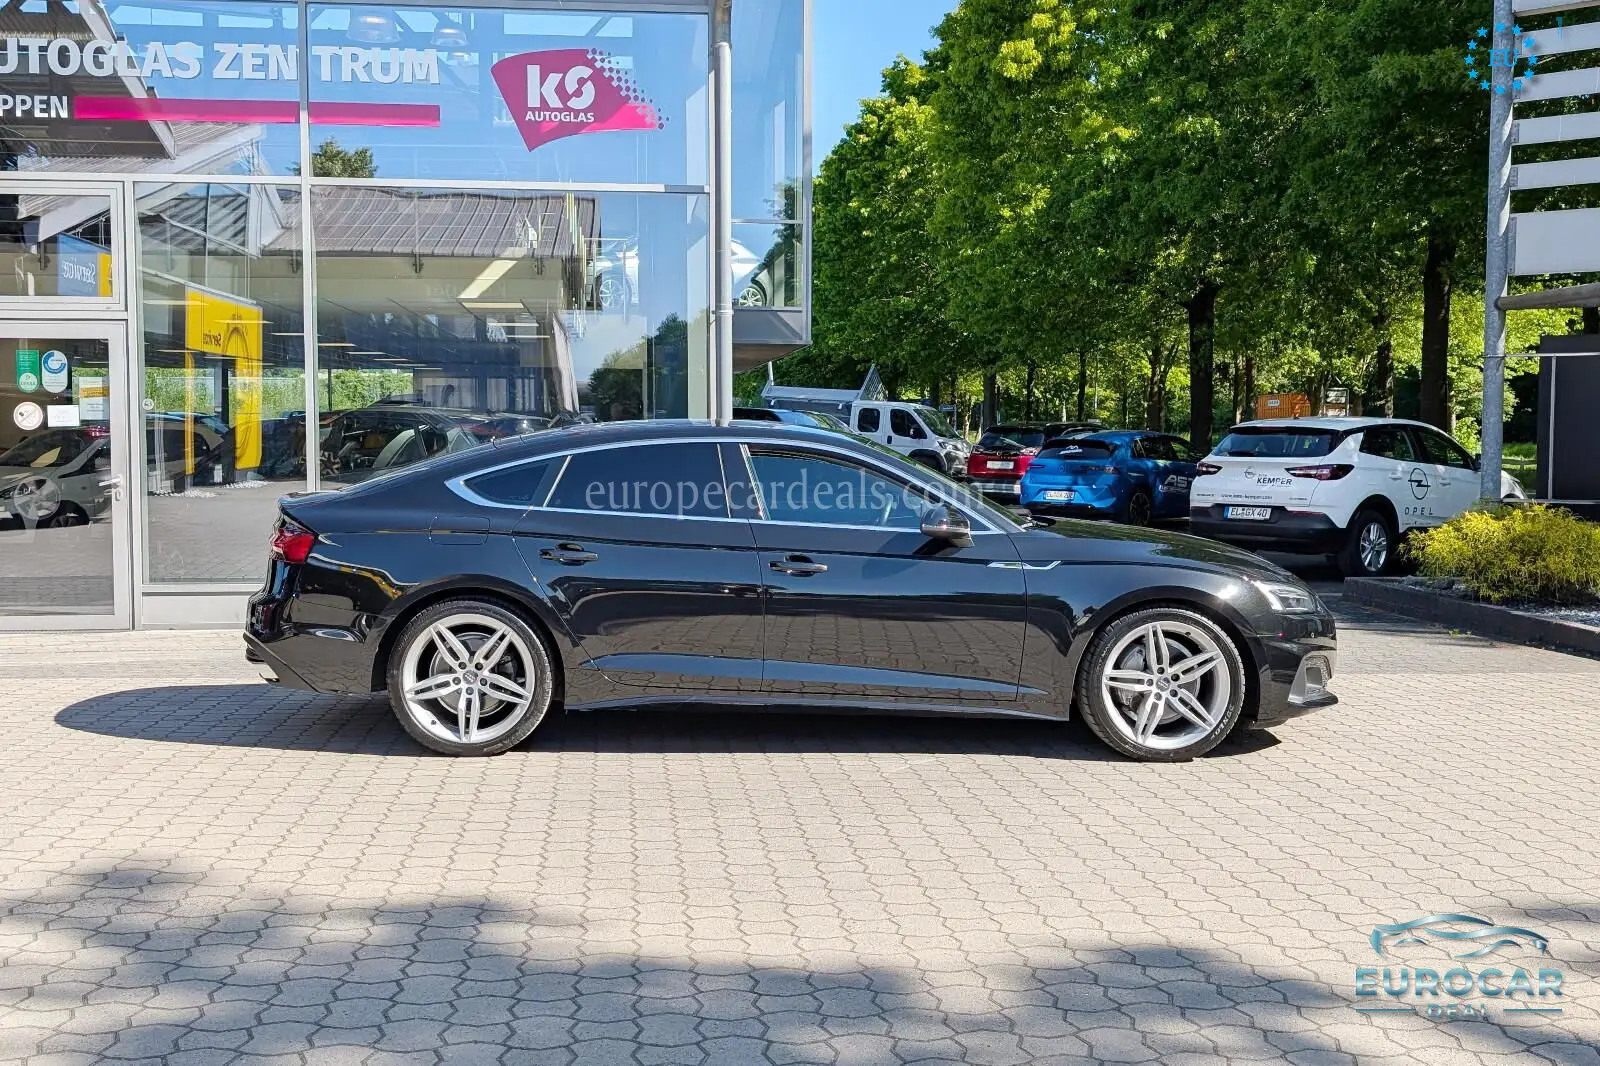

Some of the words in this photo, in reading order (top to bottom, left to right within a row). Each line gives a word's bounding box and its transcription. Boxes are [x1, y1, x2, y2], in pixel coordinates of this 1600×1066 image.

[525, 110, 595, 123] AUTOGLAS
[1256, 477, 1293, 486] KEMPER
[1404, 506, 1433, 516] OPEL
